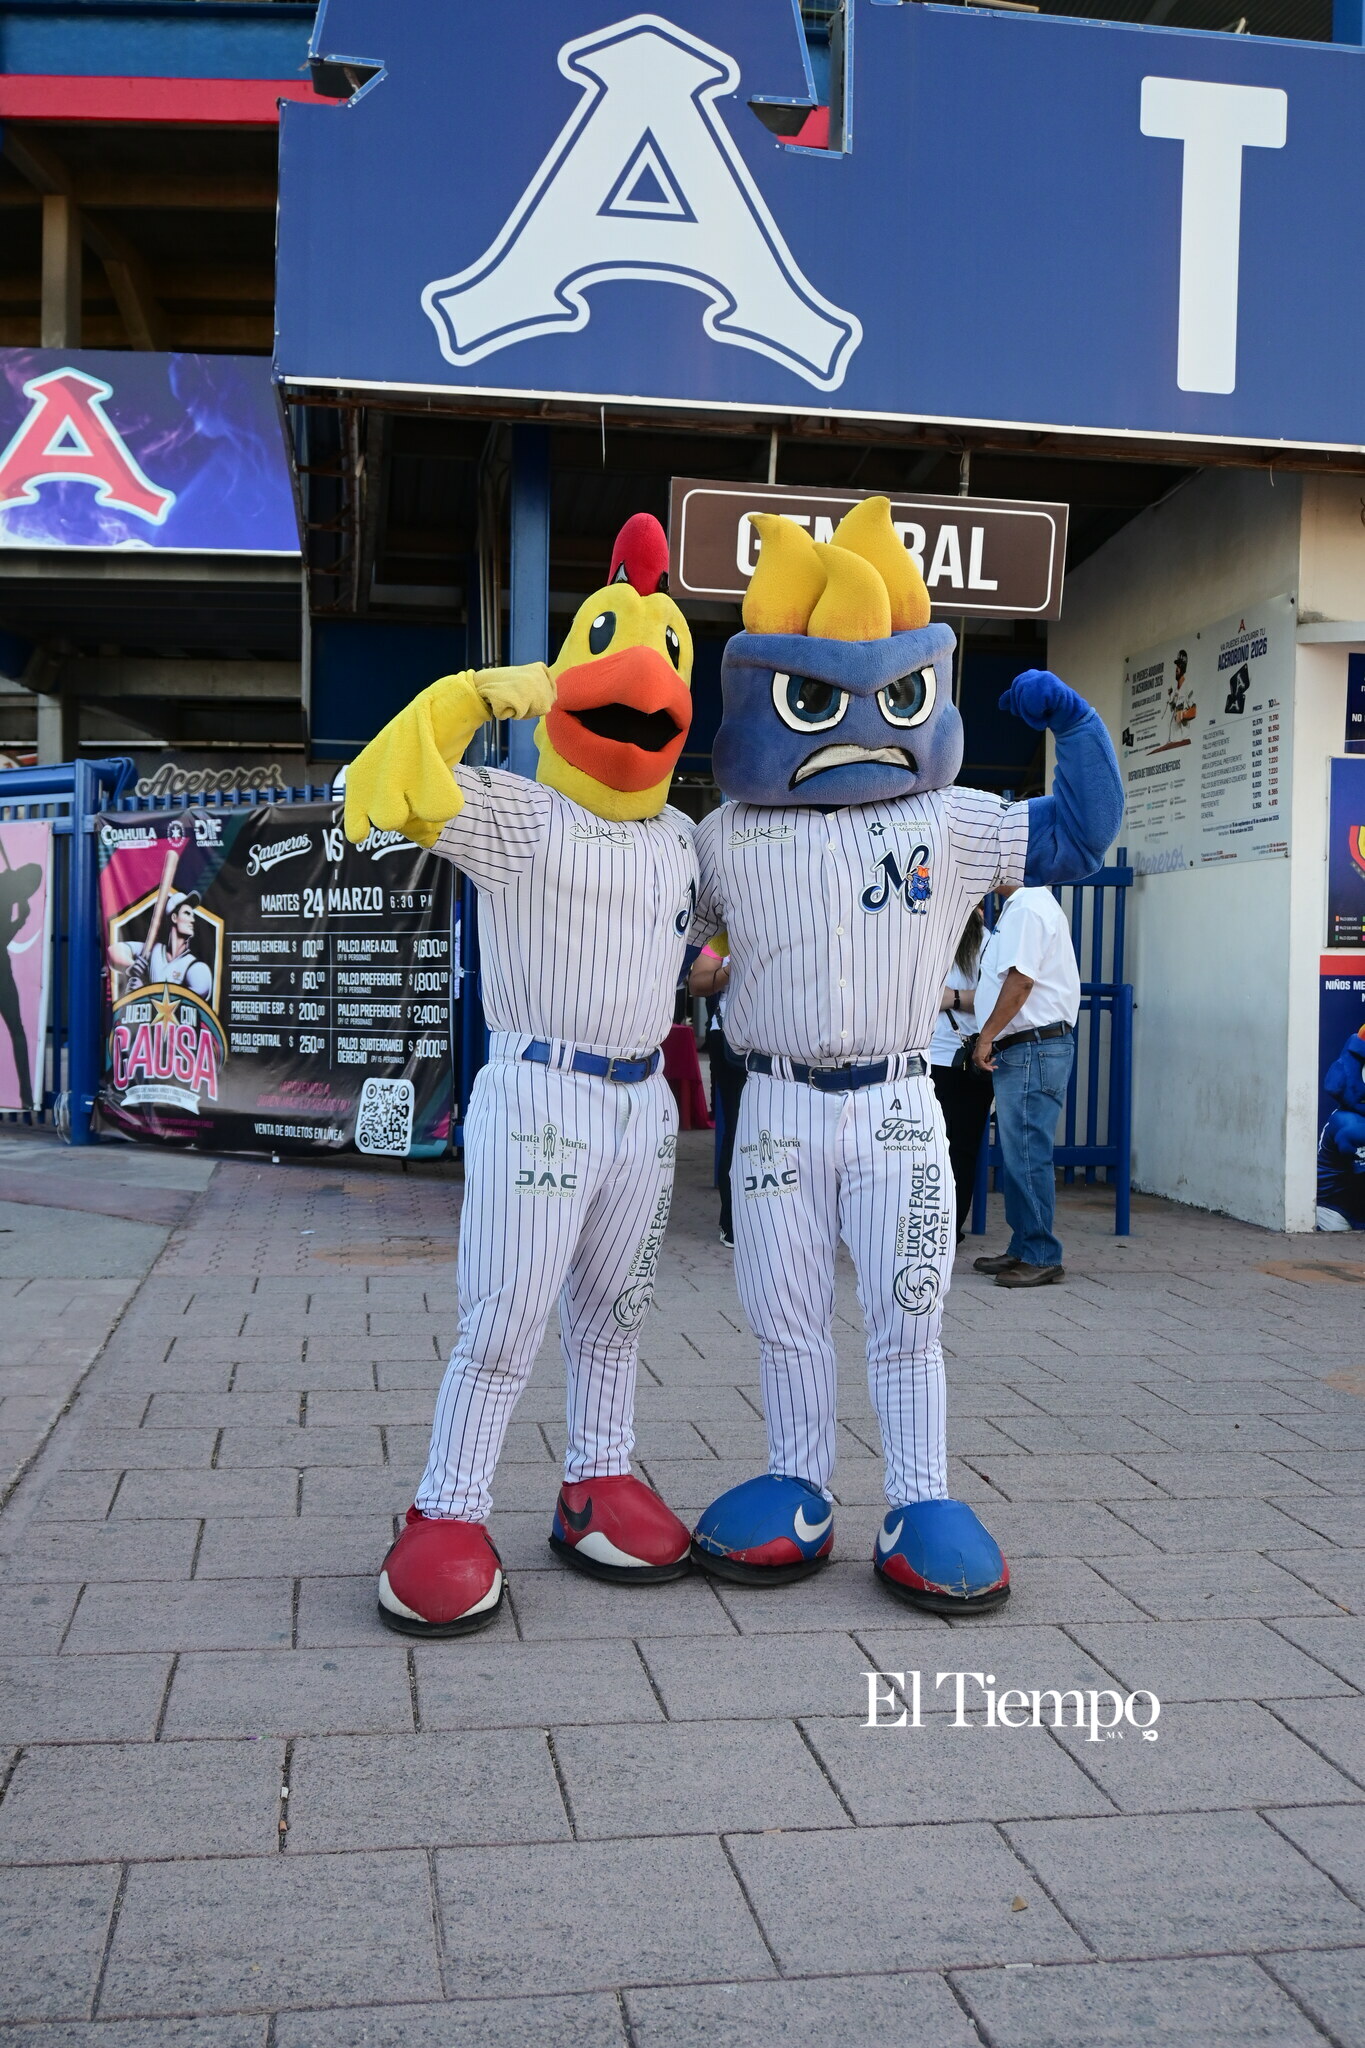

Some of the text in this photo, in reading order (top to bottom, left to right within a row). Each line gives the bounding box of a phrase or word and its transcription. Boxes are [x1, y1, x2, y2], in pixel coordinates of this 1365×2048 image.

[421, 14, 862, 391] A
[1140, 76, 1287, 395] T
[0, 368, 175, 526] A
[1217, 637, 1267, 672] ACEROBONO 2026
[1226, 639, 1240, 650] PUEDES
[135, 763, 286, 798] Acereros
[101, 825, 158, 846] COAHUILA
[194, 819, 222, 840] DIF
[246, 833, 312, 877] Saraperos
[322, 828, 344, 862] VS
[261, 893, 300, 912] MARTES
[303, 888, 324, 918] 24
[328, 887, 383, 911] MARZO
[390, 895, 413, 909] 6:30
[231, 940, 260, 953] ENTRADA
[261, 940, 290, 953] GENERAL
[292, 941, 297, 953] $
[337, 940, 359, 953] PALCO
[361, 940, 379, 953] AREA
[380, 940, 399, 953] AZUL
[231, 971, 271, 984] PREFERENTE
[290, 972, 295, 984] $
[337, 972, 359, 985] PALCO
[360, 973, 402, 986] PREFERENTE
[1325, 978, 1350, 990] NIÑOS
[121, 1003, 197, 1027] JUEGO CON
[231, 1001, 271, 1014] PREFERENTE
[271, 1002, 286, 1014] ESP.
[289, 1003, 294, 1015] $
[337, 1004, 359, 1017] PALCO
[360, 1004, 402, 1018] PREFERENTE
[231, 1033, 251, 1046] PALCO
[252, 1033, 281, 1047] CENTRAL
[289, 1035, 294, 1048] $
[337, 1037, 358, 1050] PALCO
[360, 1037, 403, 1052] SUBTERRANEO
[408, 1040, 414, 1052] $
[113, 1022, 218, 1102] CAUSA
[337, 1050, 367, 1064] DERECHO
[254, 1122, 274, 1135] VENTA
[275, 1125, 284, 1136] DE
[285, 1126, 313, 1139] BOLETOS
[314, 1128, 324, 1139] EN
[511, 1131, 587, 1150] Santa María
[875, 1118, 934, 1142] Ford
[773, 1138, 801, 1148] María
[515, 1170, 577, 1189] JAC
[745, 1169, 797, 1191] JAC
[905, 1162, 925, 1258] LUCKY EAGLE
[921, 1163, 941, 1259] CASINO
[636, 1233, 659, 1278] LUCKY
[650, 1184, 668, 1230] EAGLE
[896, 1216, 906, 1257] KICKAPOO
[938, 1208, 950, 1256] HOTEL
[627, 1238, 646, 1277] KICKAPOO
